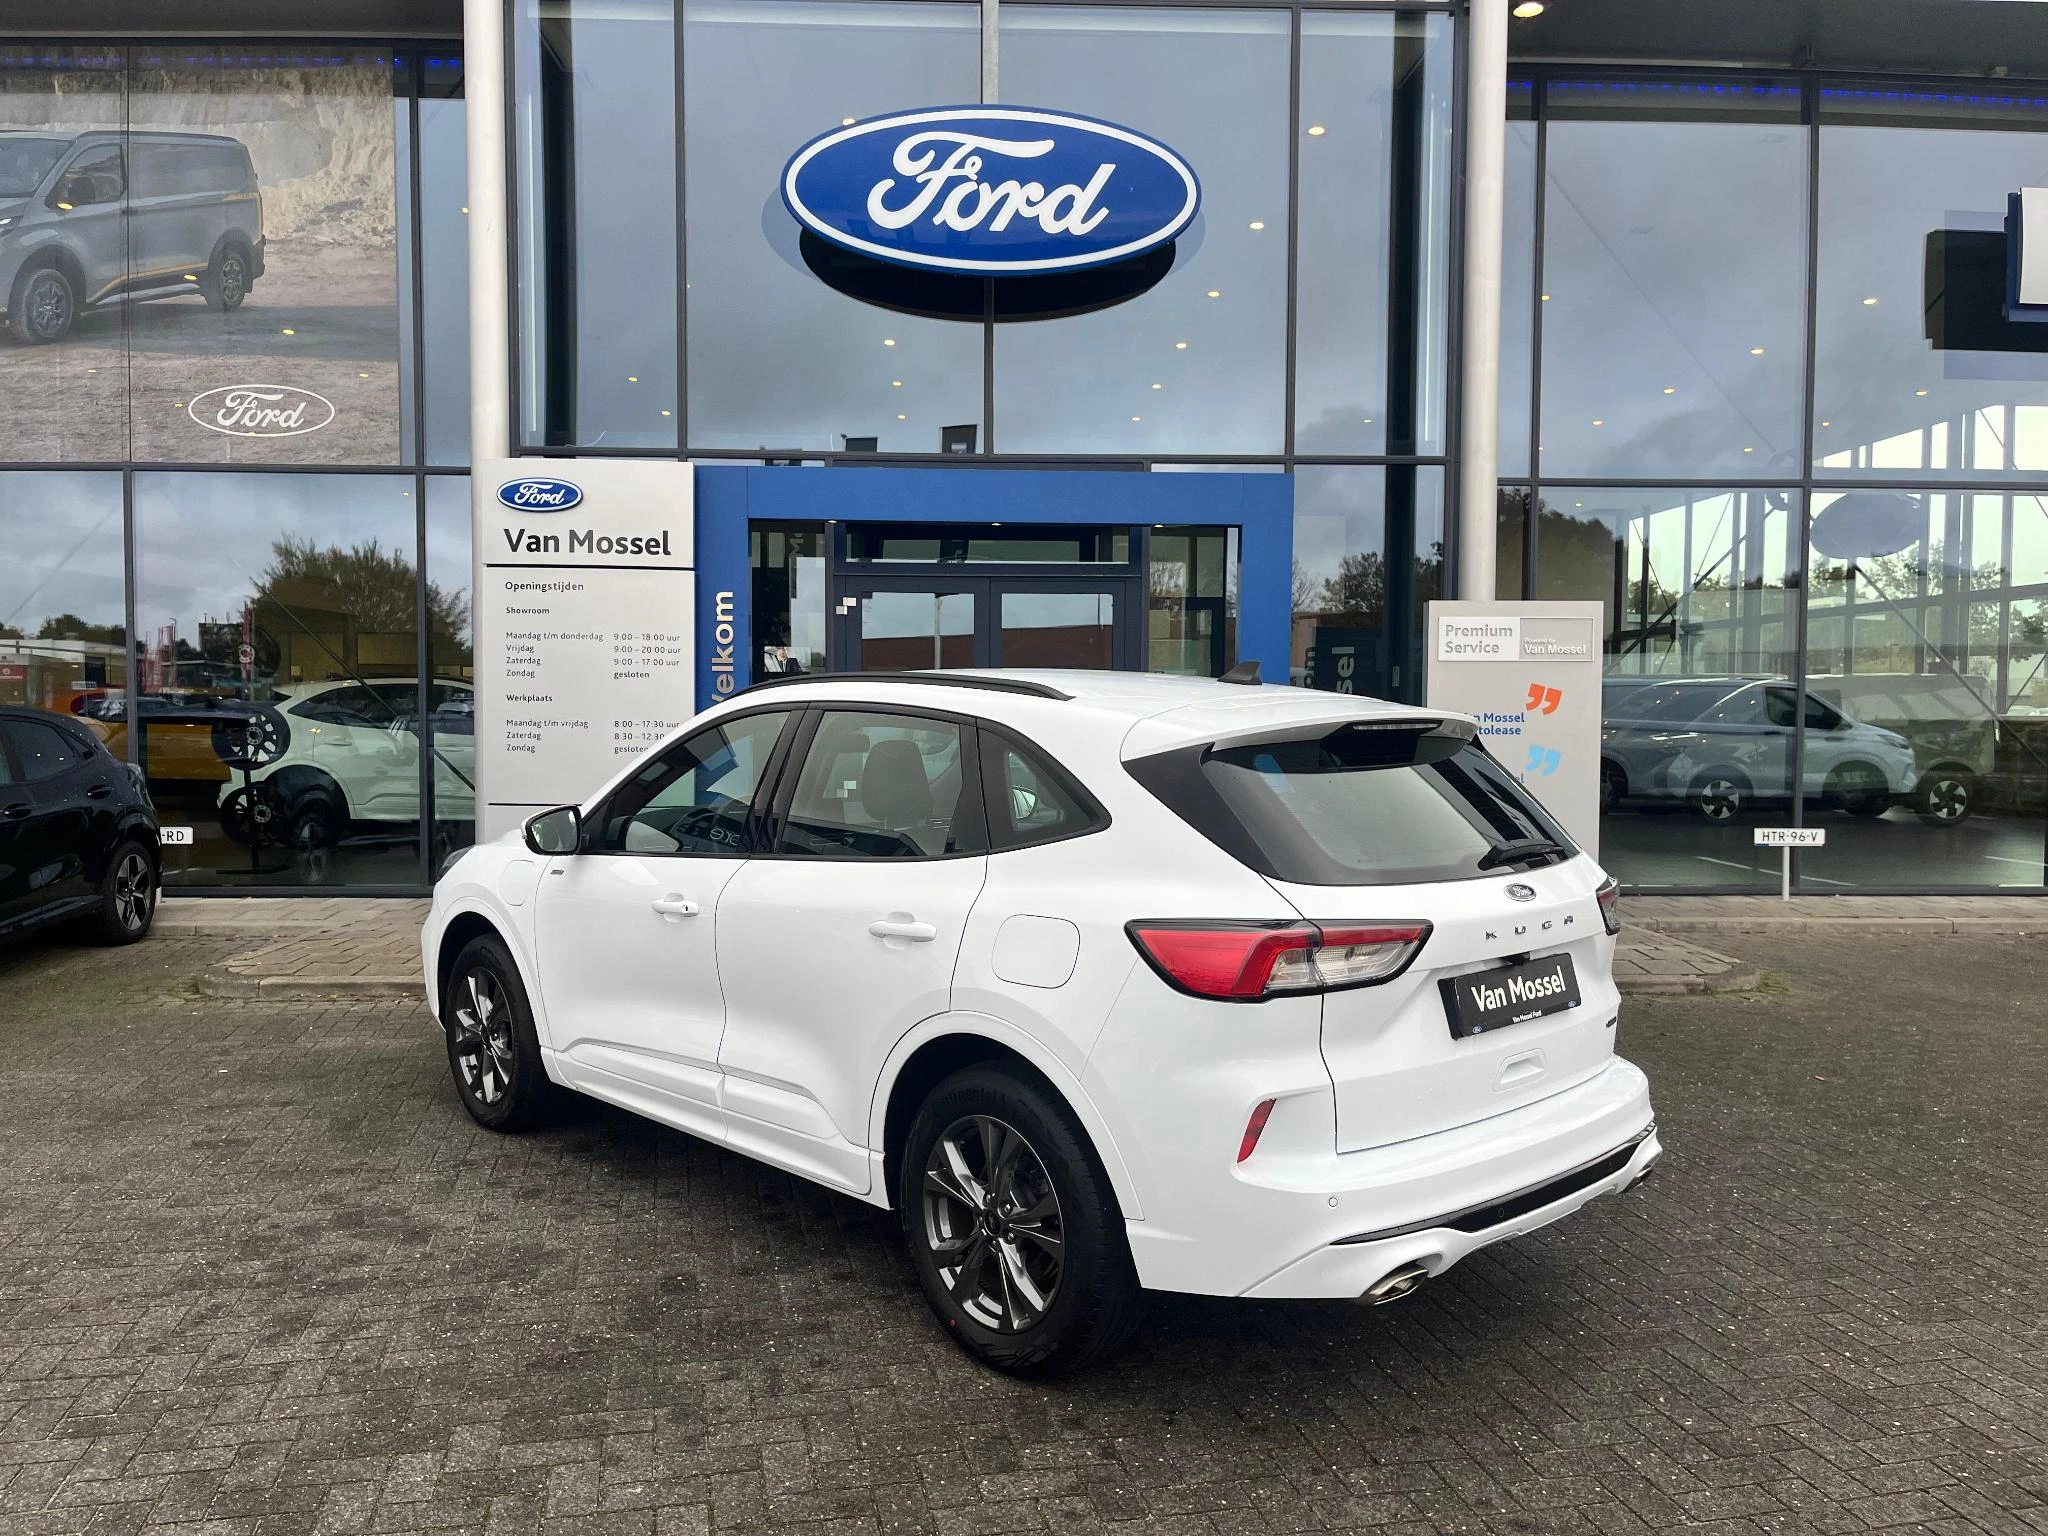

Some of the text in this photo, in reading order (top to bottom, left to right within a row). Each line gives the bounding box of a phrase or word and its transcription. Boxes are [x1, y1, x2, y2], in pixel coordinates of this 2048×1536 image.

[867, 131, 1116, 236] Ford
[217, 391, 306, 428] Ford
[514, 483, 565, 504] Ford
[503, 528, 672, 556] Van Mossel
[505, 581, 584, 592] Openingstijden
[506, 606, 550, 615] Showroom
[1445, 625, 1513, 637] Premium
[505, 631, 542, 642] Maandag
[543, 631, 559, 641] t/m
[560, 631, 604, 643] donderdag
[666, 634, 681, 642] uur
[505, 644, 535, 655] Vrijdag
[667, 647, 682, 655] uur
[1445, 641, 1500, 654] Service
[1524, 644, 1586, 654] Van Mossel
[505, 656, 542, 667] Zaterdag
[665, 659, 681, 667] uur
[506, 669, 650, 680] Zondag gesloten
[506, 693, 553, 703] Werkplaats
[1484, 712, 1525, 722] Mossel
[506, 719, 543, 730] Maandag
[544, 719, 559, 729] t/m
[560, 719, 589, 730] vrijdag
[614, 720, 633, 729] 8:00
[641, 720, 664, 729] 17:30
[1479, 725, 1521, 735] tolease
[506, 731, 542, 742] Zaterdag
[614, 732, 633, 741] 8:30
[506, 743, 535, 754] Zondag
[162, 830, 184, 842] -RD
[1762, 831, 1818, 842] HTR-96-V
[1485, 914, 1574, 941] KUGA
[1471, 965, 1567, 1012] Van Mossel
